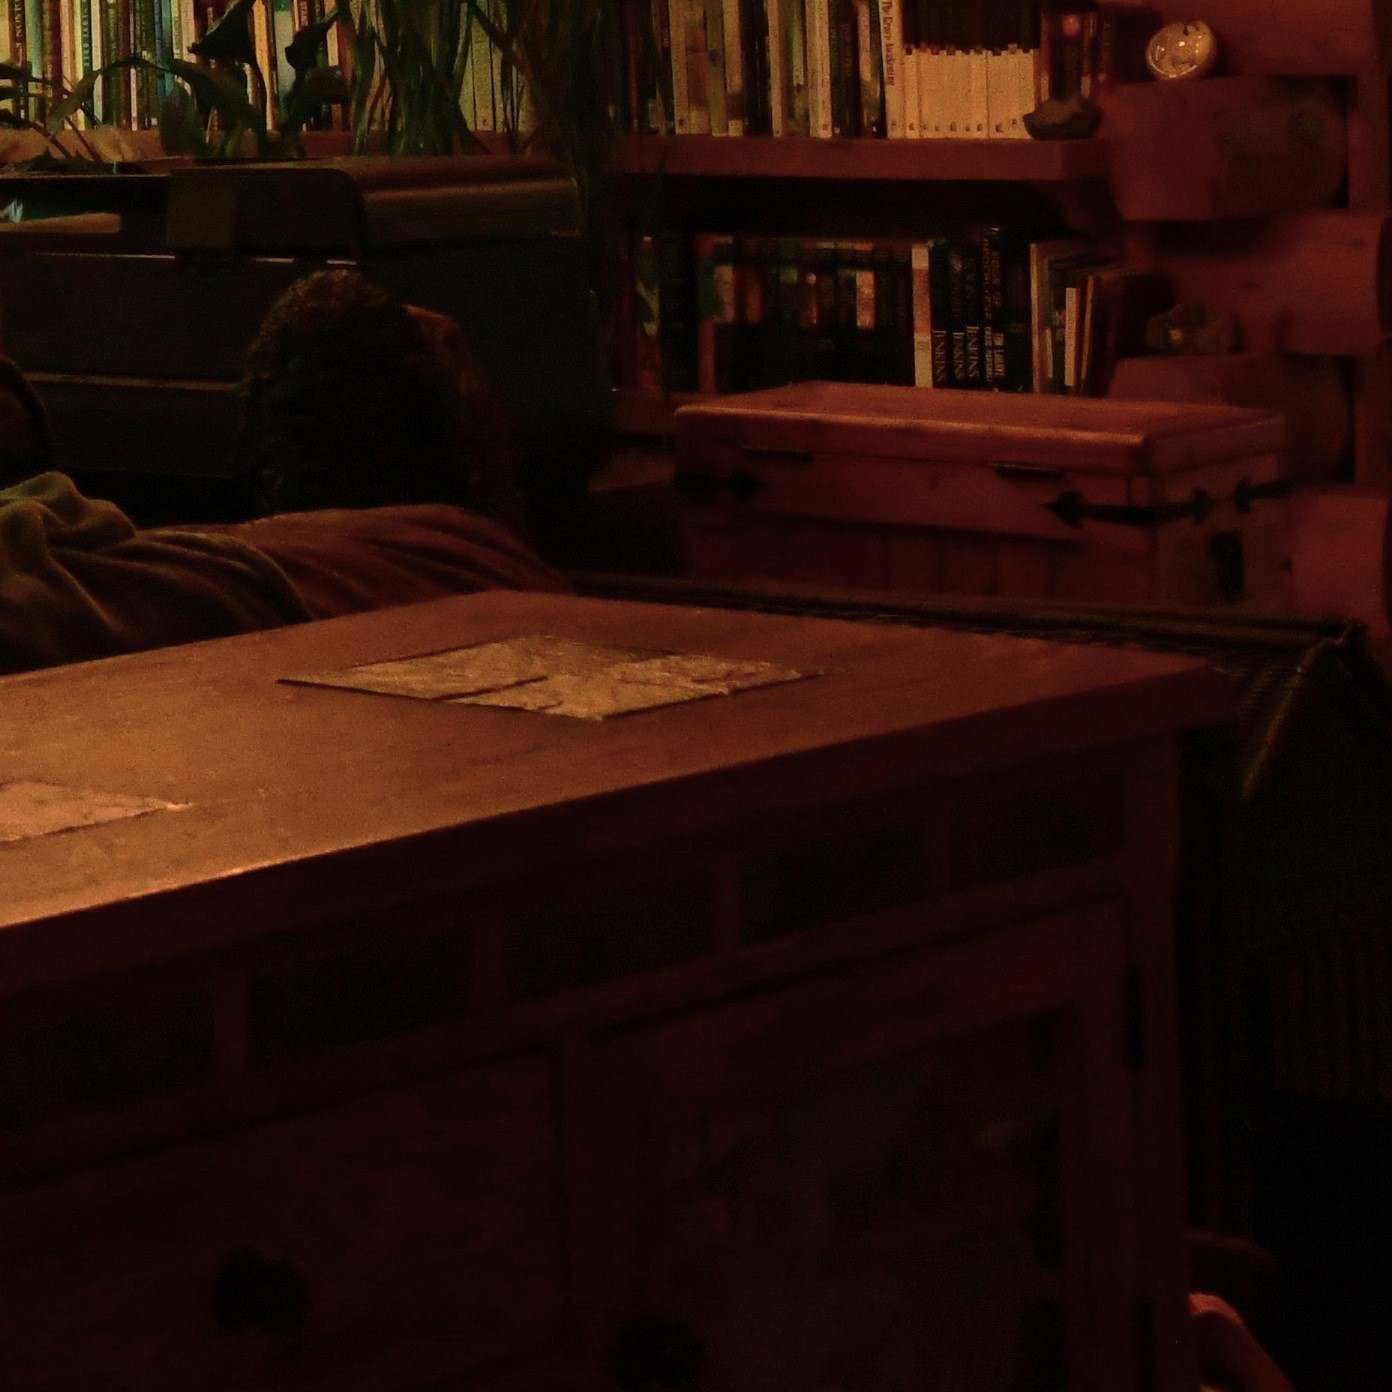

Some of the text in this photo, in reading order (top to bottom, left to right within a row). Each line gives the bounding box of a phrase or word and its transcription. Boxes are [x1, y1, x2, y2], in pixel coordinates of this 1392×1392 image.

[932, 329, 946, 382] JENKINS
[951, 332, 965, 379] JENKINS
[966, 325, 980, 378] JENKINS
